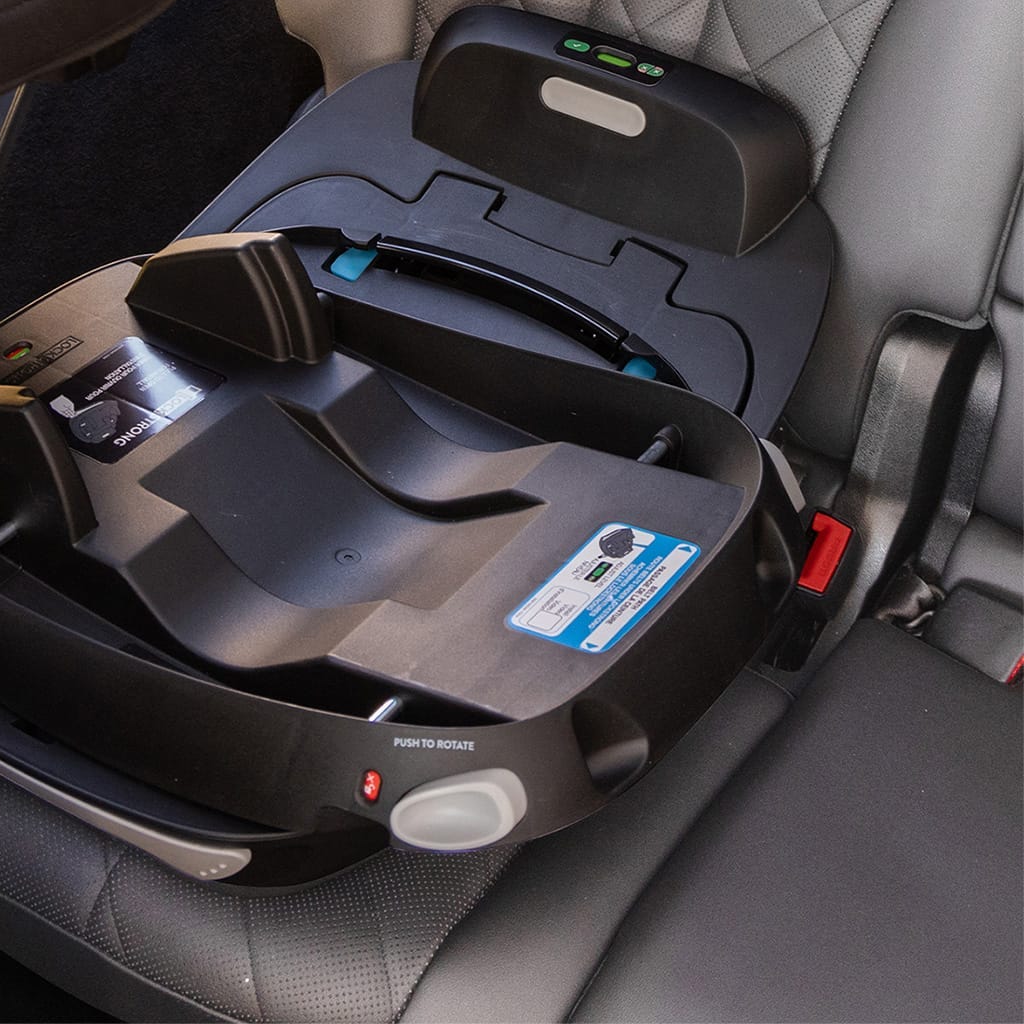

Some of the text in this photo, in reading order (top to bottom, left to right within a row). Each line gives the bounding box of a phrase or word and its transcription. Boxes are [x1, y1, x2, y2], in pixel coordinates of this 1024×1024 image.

[394, 737, 475, 751] PUSH TO ROTATE
